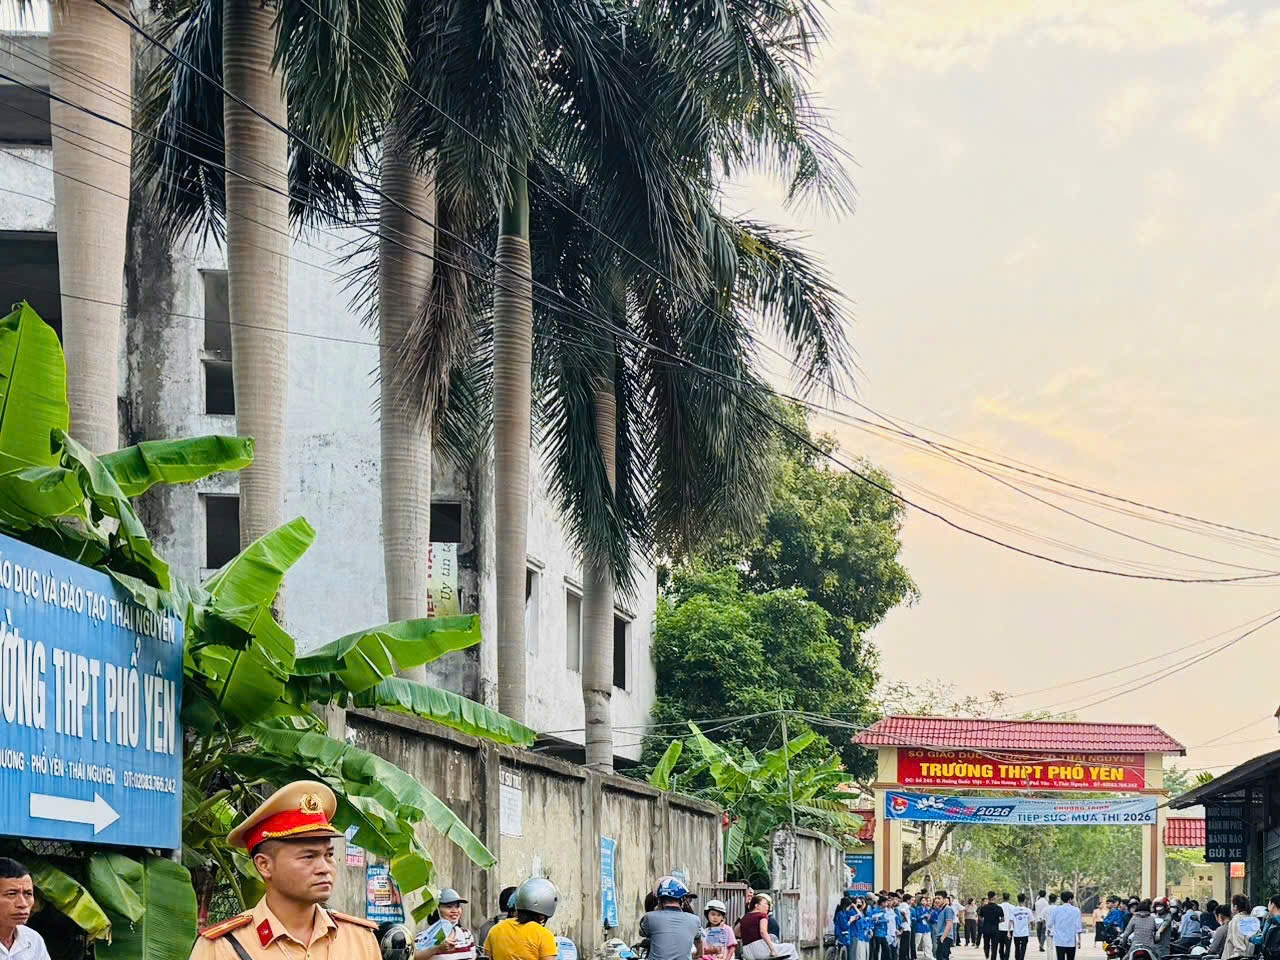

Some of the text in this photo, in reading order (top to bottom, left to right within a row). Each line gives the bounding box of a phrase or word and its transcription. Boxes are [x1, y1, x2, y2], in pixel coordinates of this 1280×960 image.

[14, 563, 40, 604] DỤC
[41, 570, 58, 606] VÀ
[60, 576, 84, 614] ĐÀO
[86, 590, 107, 627] TẠO
[110, 598, 134, 631] THÁI
[136, 606, 175, 644] NGUYÊN
[0, 608, 176, 756] ỜNG THPT PHỔ YÊN
[0, 747, 25, 771] ƯƠNG
[31, 746, 48, 775] PHỔ
[48, 753, 65, 777] YÊN
[68, 757, 86, 780] THÁI
[86, 763, 116, 785] NGUYÊN
[919, 759, 994, 778] TRƯỜNG
[998, 763, 1043, 779] THPT
[1088, 764, 1124, 780] YÊN
[977, 807, 1010, 816] 2026
[1101, 813, 1119, 822] THI
[1123, 812, 1151, 822] 2026
[1208, 844, 1242, 858] GỬI XE
